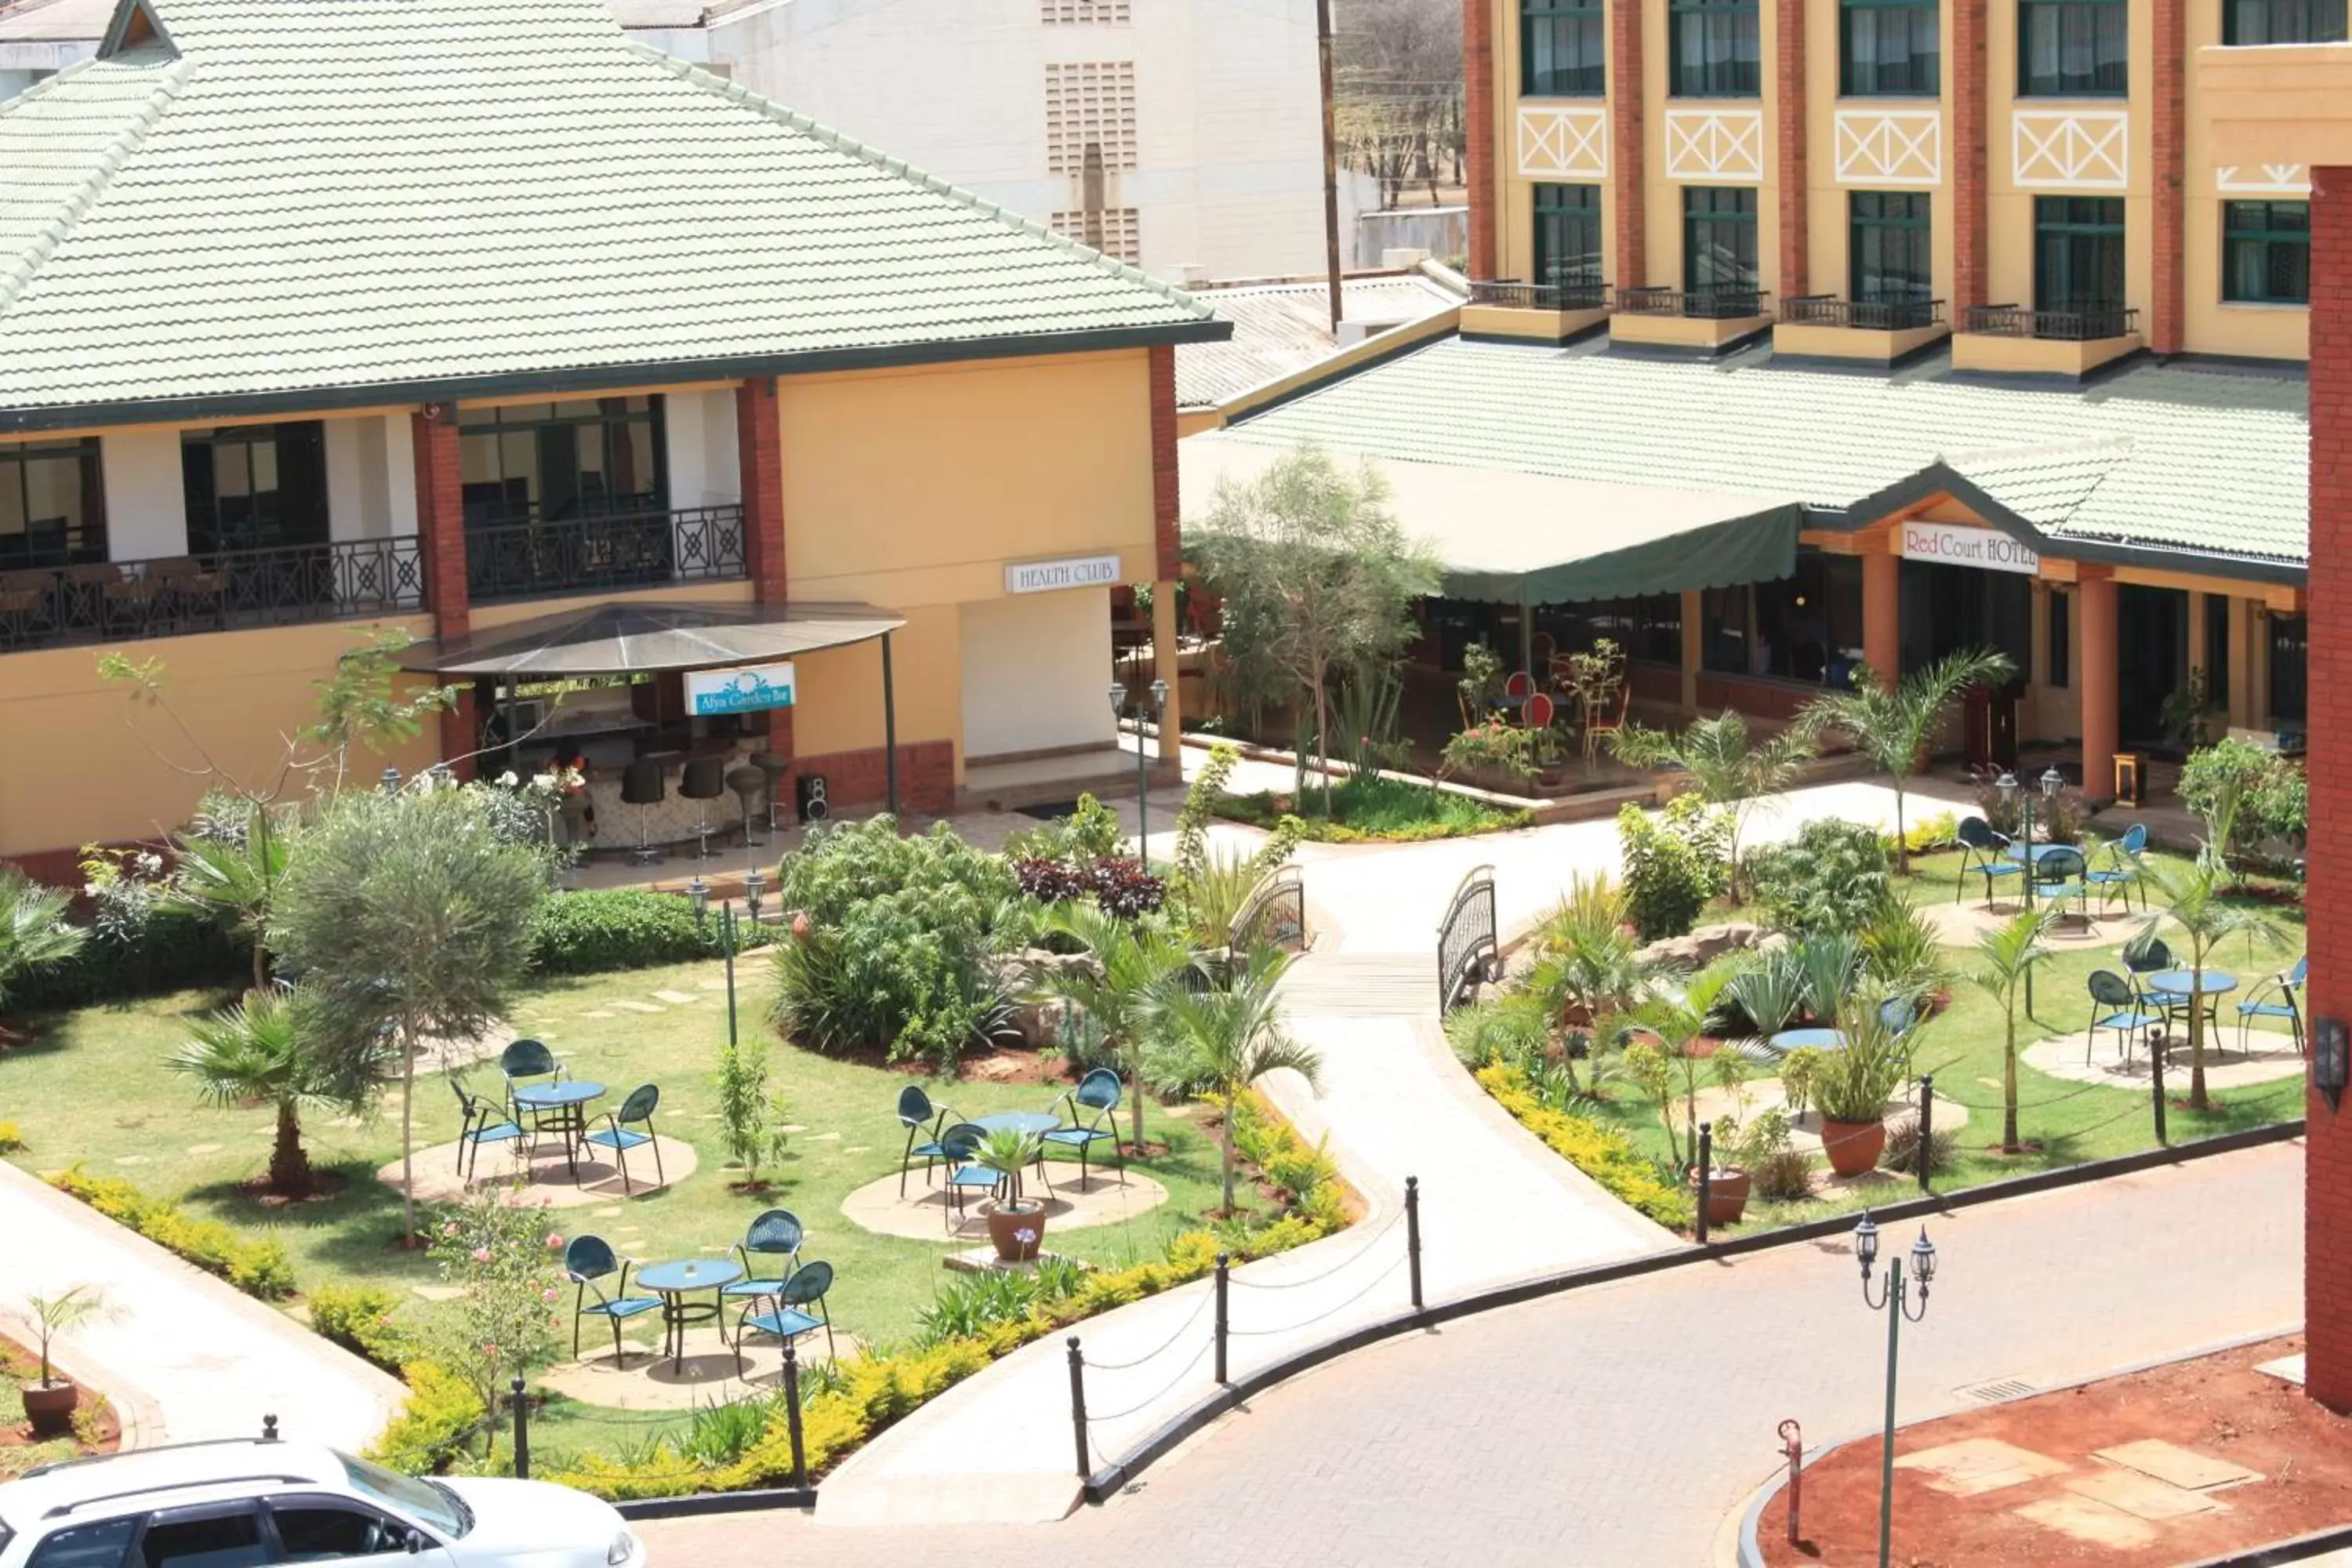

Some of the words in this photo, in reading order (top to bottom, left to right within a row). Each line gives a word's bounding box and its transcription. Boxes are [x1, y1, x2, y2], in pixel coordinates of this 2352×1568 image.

[1907, 530, 1937, 554] Red
[1940, 534, 1982, 558] Court
[1020, 565, 1069, 588] HEALTH
[1073, 562, 1112, 581] CLUB
